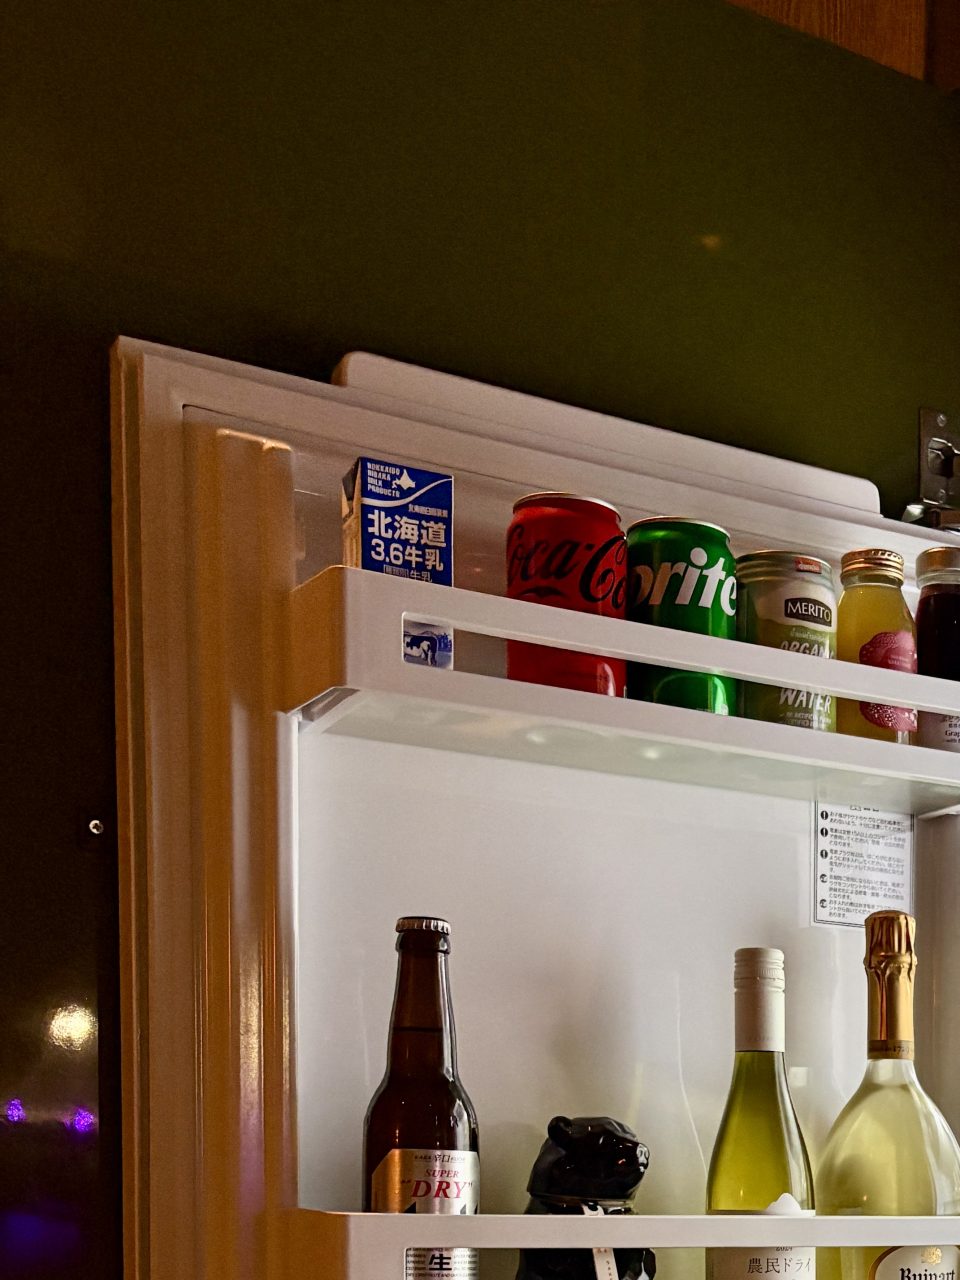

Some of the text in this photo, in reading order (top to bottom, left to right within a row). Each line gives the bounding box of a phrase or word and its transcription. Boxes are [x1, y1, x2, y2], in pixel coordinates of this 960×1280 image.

[367, 509, 446, 547] 北海道
[370, 538, 444, 571] 3.6牛乳
[630, 547, 736, 616] rite
[787, 602, 831, 622] MERITO
[780, 641, 834, 659] ORGAN
[779, 687, 832, 714] WATER
[424, 1169, 460, 1178] SUPER
[429, 1254, 452, 1271] 生
[747, 1258, 811, 1274] 農民ドライ
